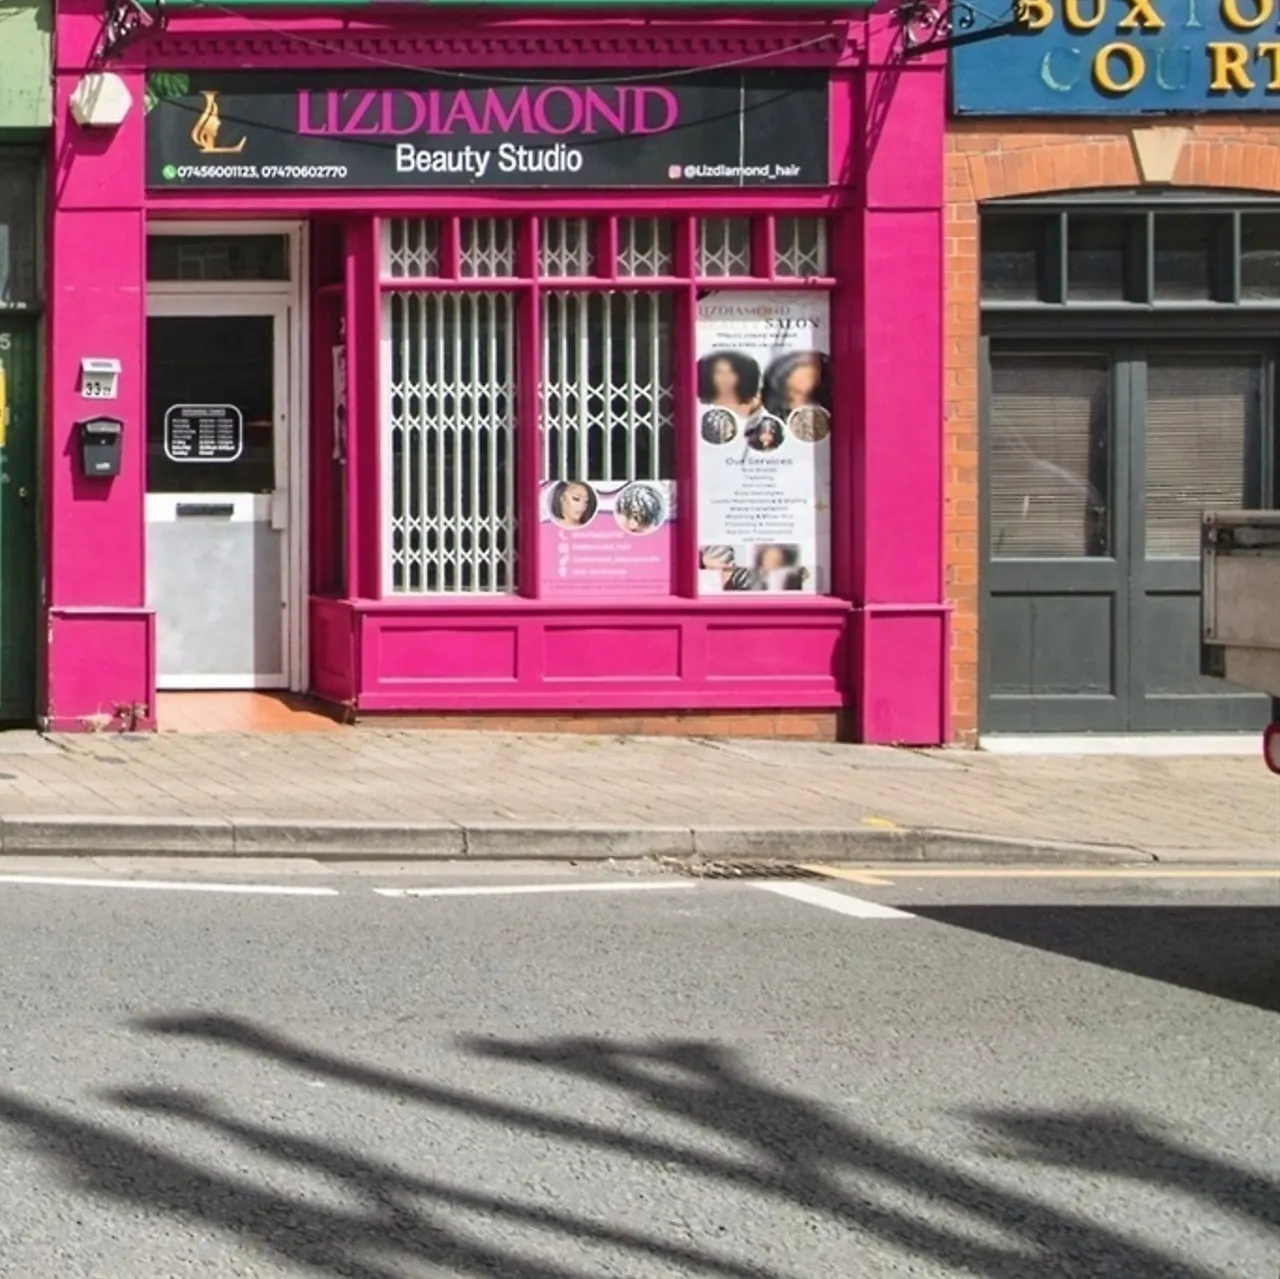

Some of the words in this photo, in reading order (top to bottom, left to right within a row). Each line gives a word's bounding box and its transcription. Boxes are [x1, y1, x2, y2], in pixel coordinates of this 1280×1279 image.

[296, 85, 679, 136] LIZDIAMOND
[261, 165, 348, 179] 07470602770
[395, 141, 490, 174] Beauty
[497, 141, 583, 173] Studio
